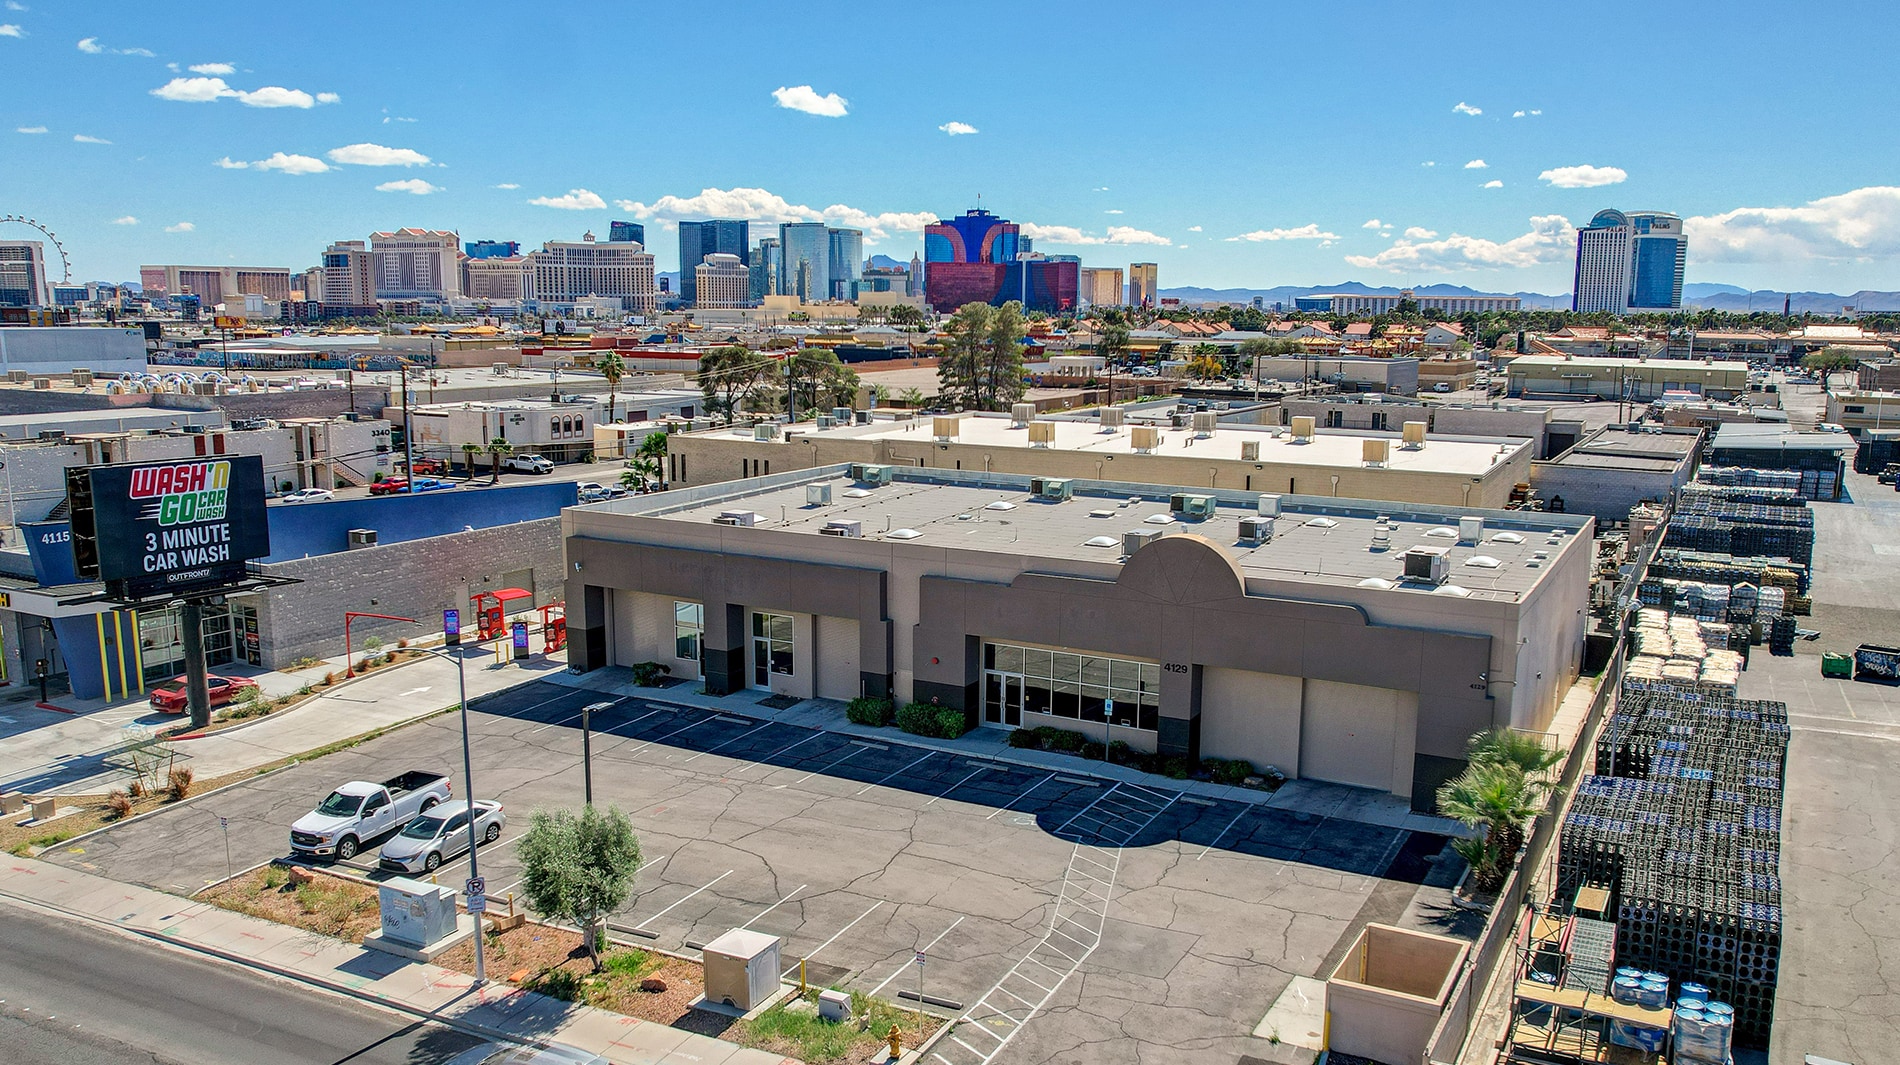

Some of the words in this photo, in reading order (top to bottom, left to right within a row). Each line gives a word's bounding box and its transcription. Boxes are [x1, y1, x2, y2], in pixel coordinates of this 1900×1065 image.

[198, 489, 226, 508] CAR
[160, 493, 198, 525] GO
[196, 507, 225, 521] WASH
[41, 530, 70, 545] 4115
[145, 532, 158, 552] 3
[162, 523, 231, 550] MINUTE
[143, 551, 179, 572] CAR
[181, 543, 230, 567] WASH
[1164, 663, 1188, 673] 4129
